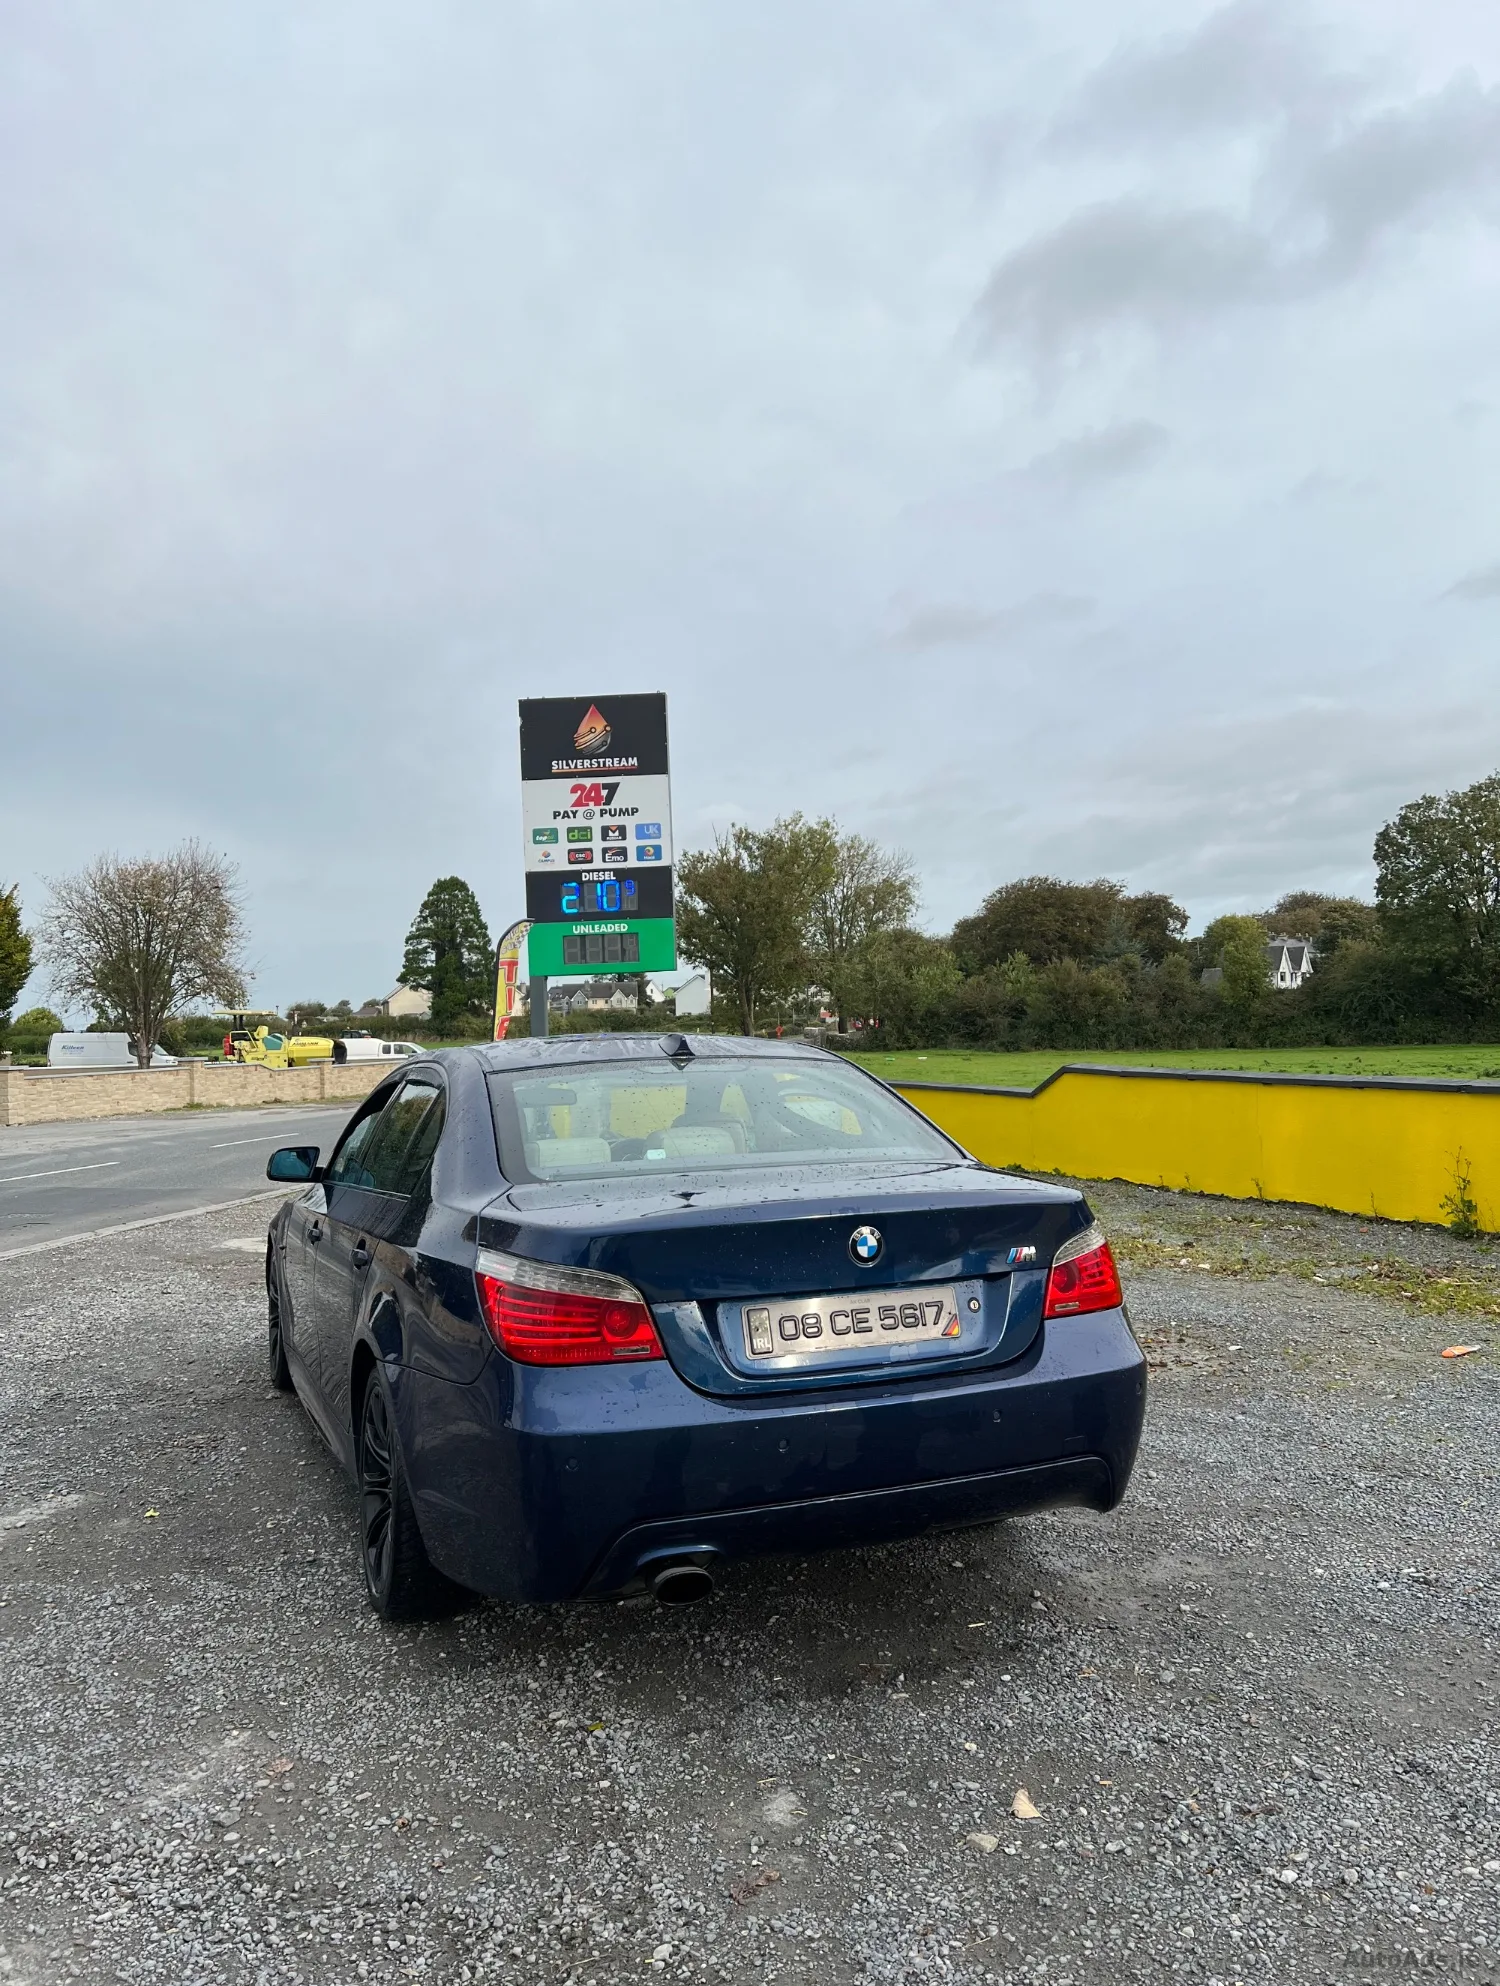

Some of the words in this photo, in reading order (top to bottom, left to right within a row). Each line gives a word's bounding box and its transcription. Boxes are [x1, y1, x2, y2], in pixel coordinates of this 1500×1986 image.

[551, 757, 638, 769] SILVERSTREAM
[569, 782, 620, 807] 247
[553, 810, 580, 820] PAY
[582, 808, 595, 820] @
[599, 807, 639, 818] PUMP
[569, 828, 591, 840] dci
[645, 825, 660, 833] UK
[606, 853, 625, 862] Emo
[581, 871, 616, 881] DIESEL
[572, 923, 628, 934] UNLEADED
[778, 1313, 823, 1341] 08
[830, 1308, 873, 1335] CE
[878, 1301, 944, 1330] 5617
[753, 1338, 771, 1349] IRL
